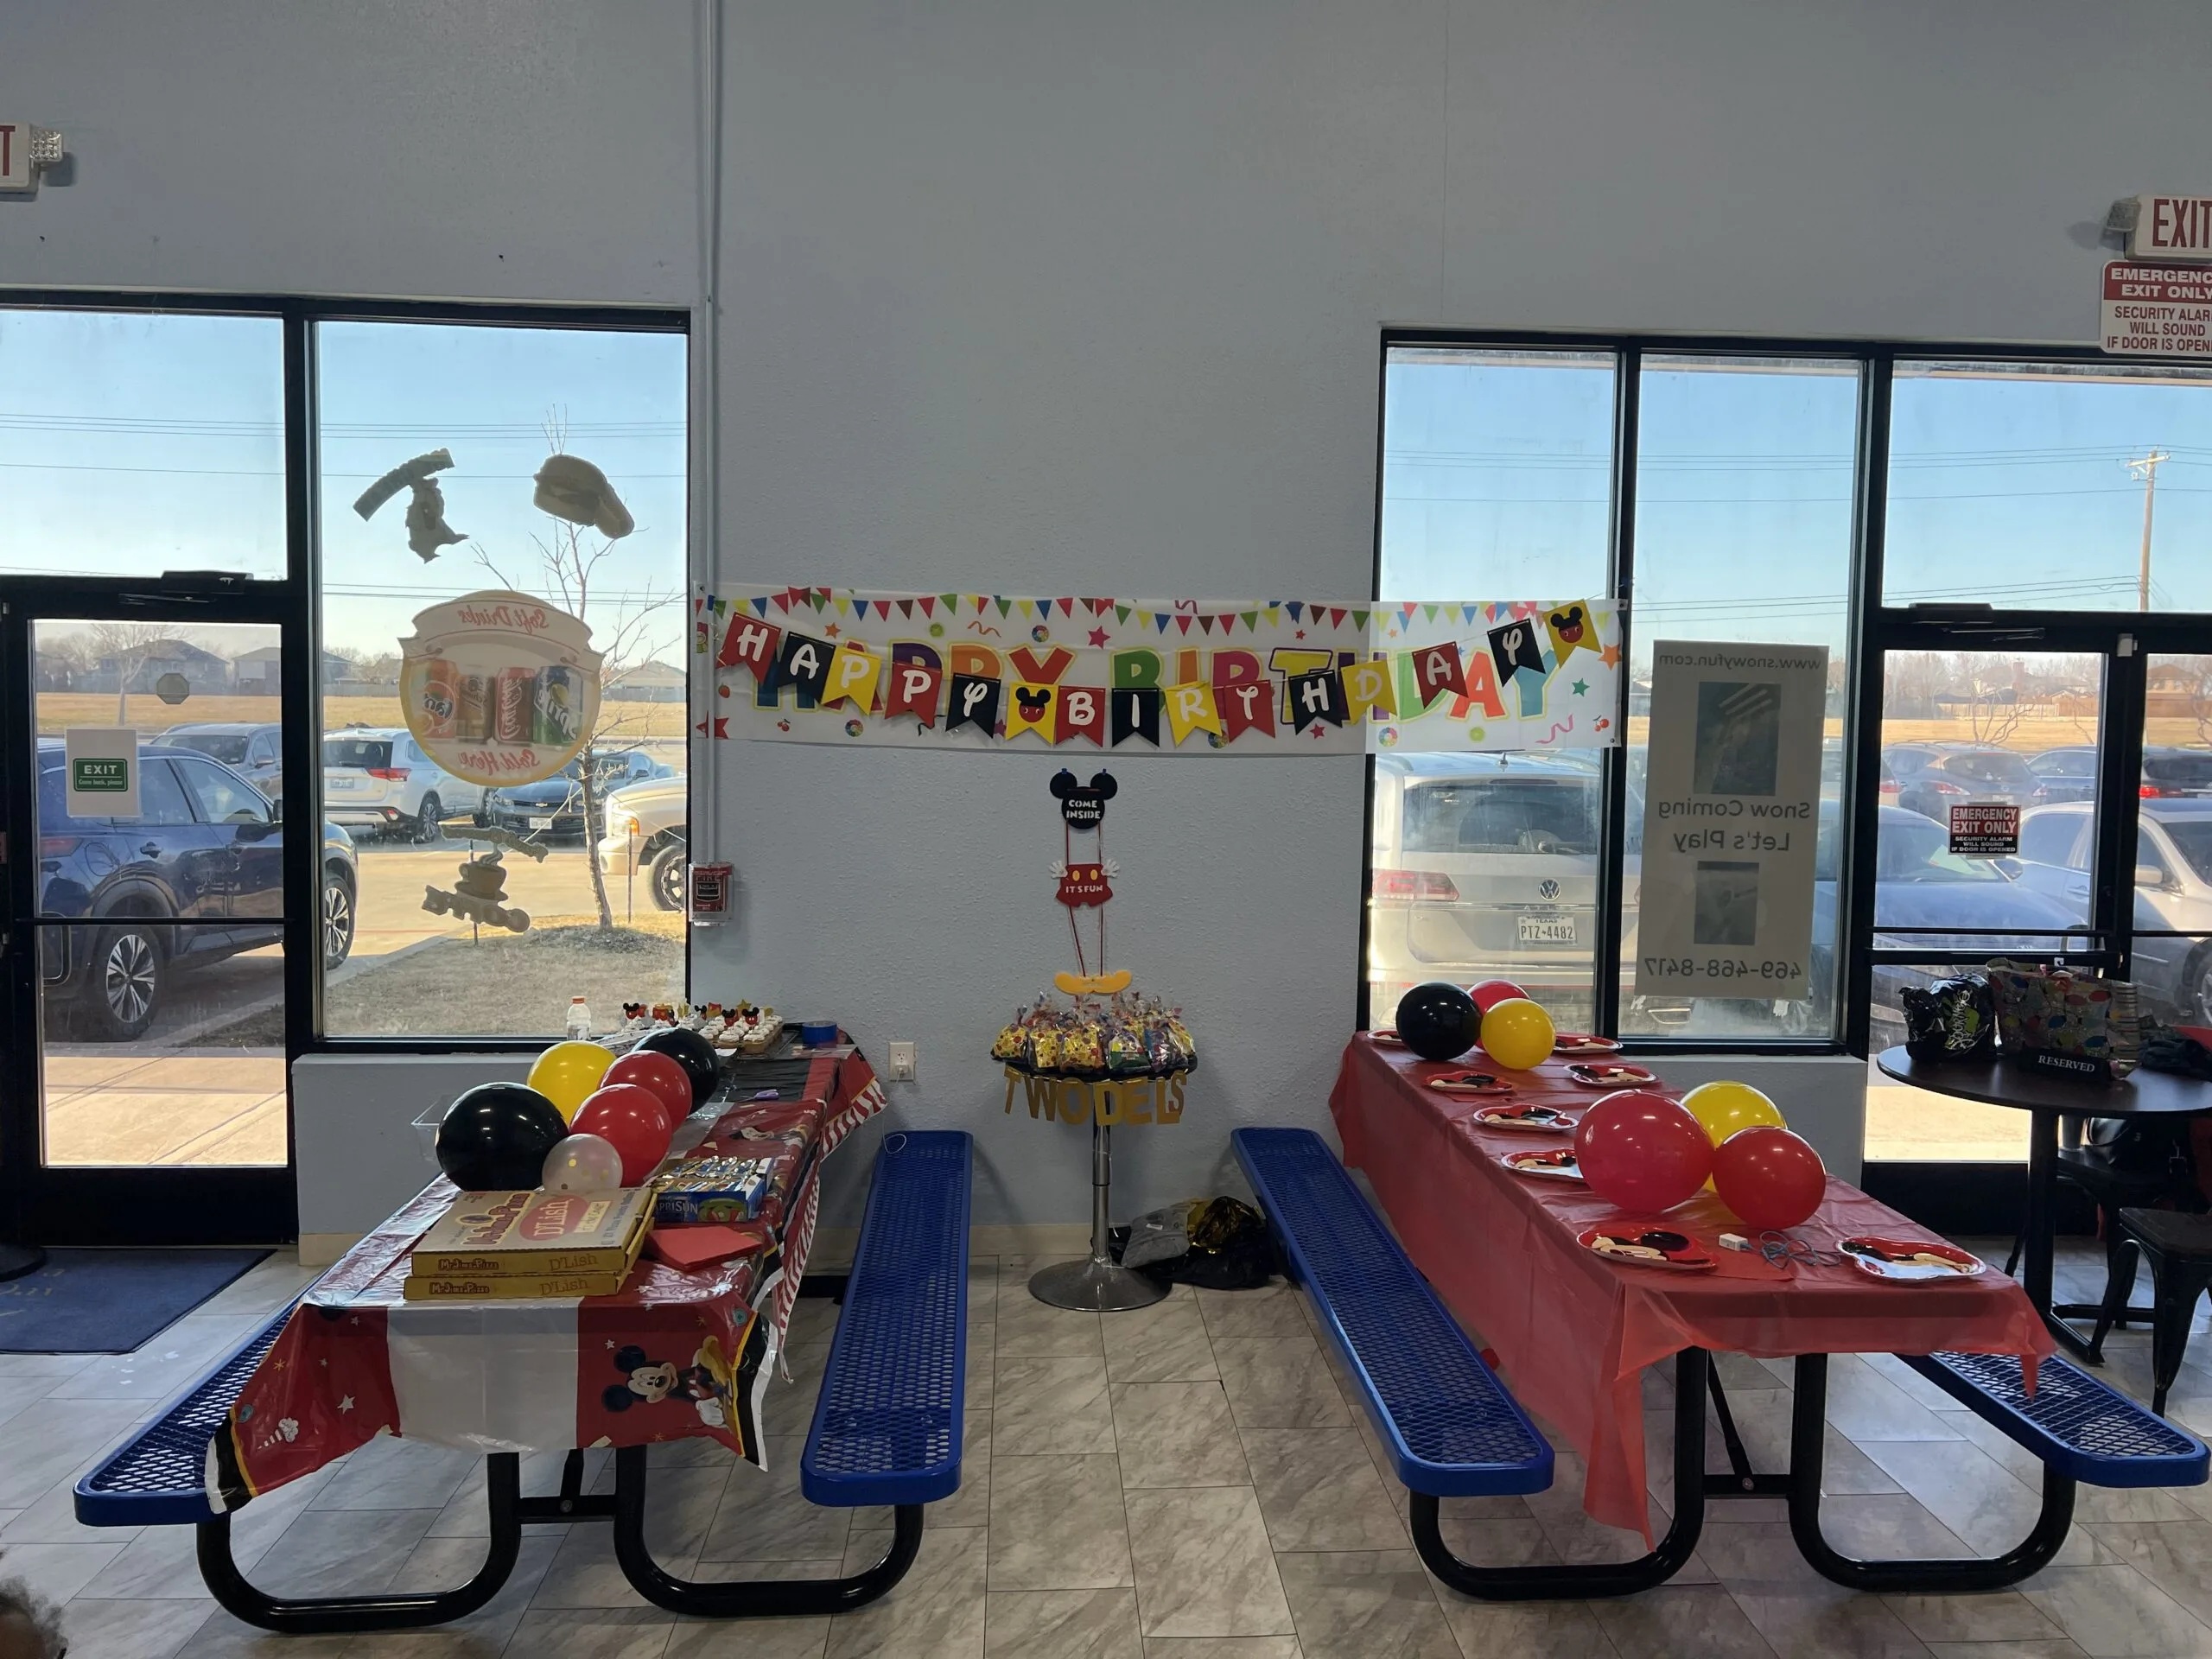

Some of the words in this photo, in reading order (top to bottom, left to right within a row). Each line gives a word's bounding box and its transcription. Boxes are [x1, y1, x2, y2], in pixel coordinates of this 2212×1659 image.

[2152, 198, 2212, 248] EXIT
[2121, 284, 2162, 297] EXIT
[2167, 285, 2212, 299] ONLY
[2114, 306, 2176, 320] SECURITY
[2178, 308, 2212, 321] ALAR
[2130, 321, 2159, 334] WILL
[2162, 323, 2206, 337] SOUND
[2107, 336, 2119, 348] IF
[2121, 337, 2158, 350] DOOR
[2161, 338, 2173, 351] IS
[2177, 339, 2212, 353] OPEN
[737, 623, 988, 717] HAPPY
[1068, 628, 1522, 728] BIRTHDAY
[84, 765, 118, 774] EXIT
[1068, 799, 1098, 809] COME
[1065, 810, 1101, 820] INSIDE
[1953, 808, 2017, 820] EMERGENCY
[1953, 821, 1980, 834] EXIT
[1984, 821, 2017, 834] ONLY
[2037, 1054, 2096, 1072] RESERVED
[549, 1253, 599, 1272] D'Lish
[539, 1277, 589, 1296] D'Lish
